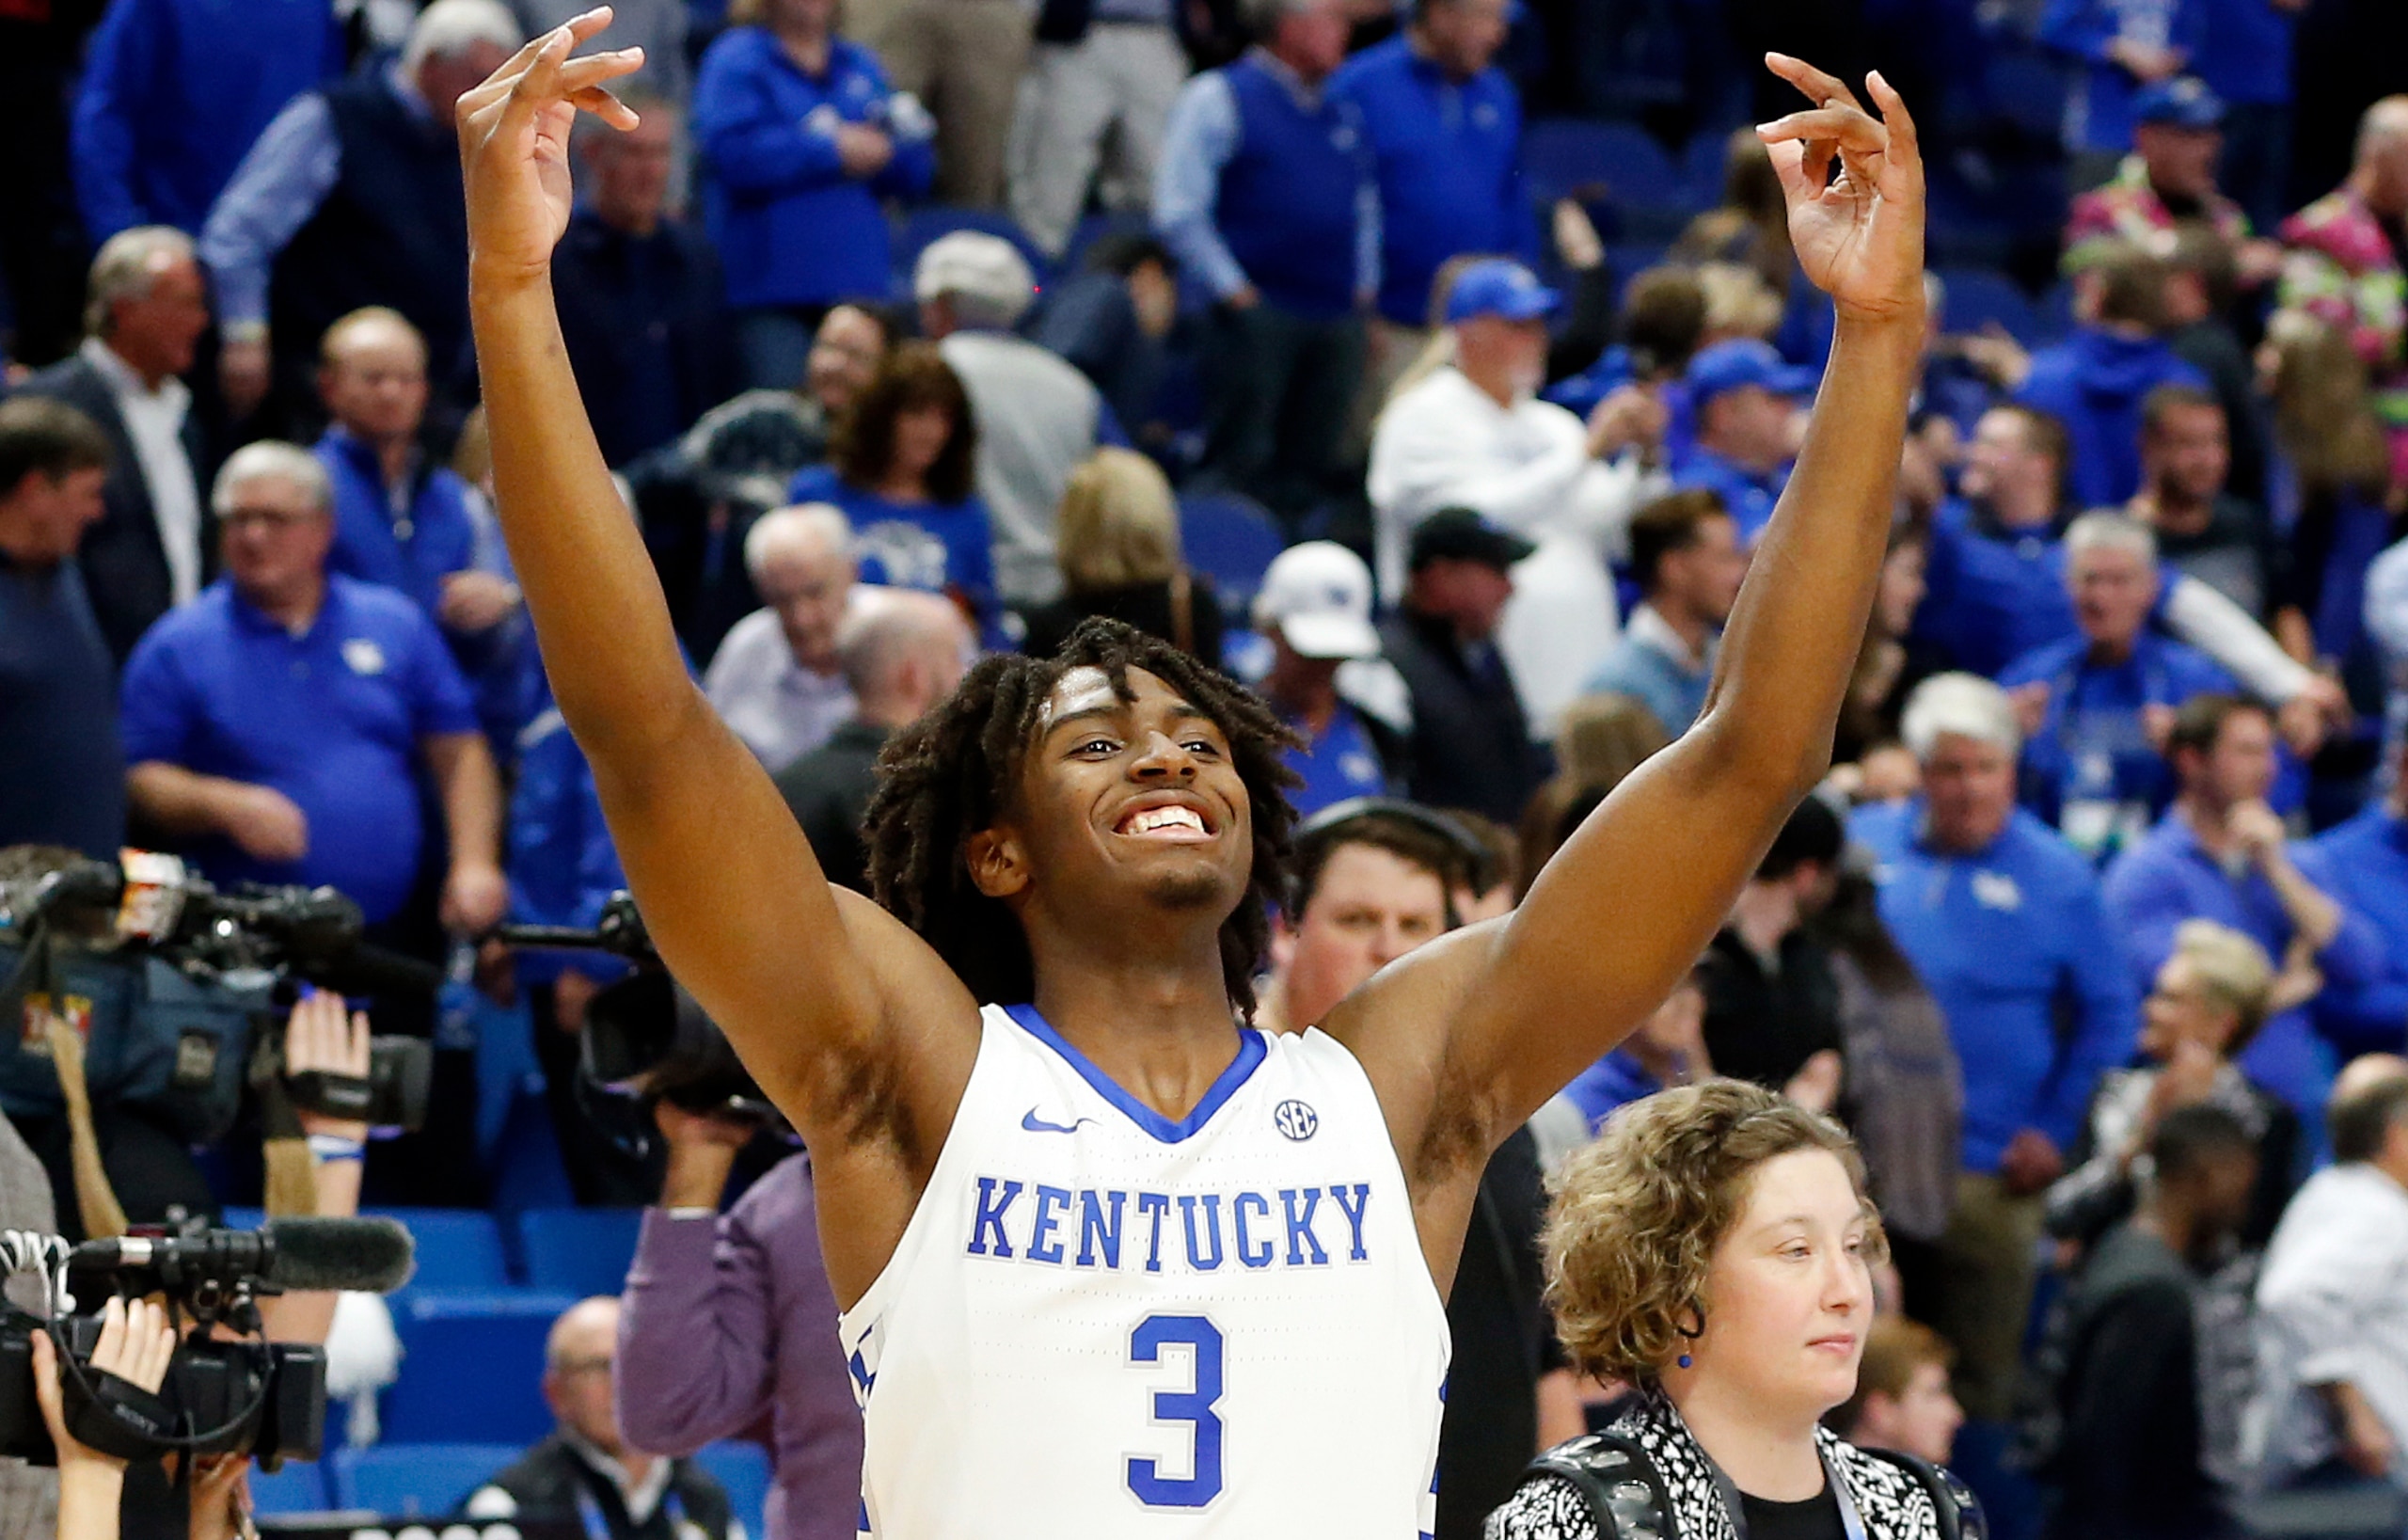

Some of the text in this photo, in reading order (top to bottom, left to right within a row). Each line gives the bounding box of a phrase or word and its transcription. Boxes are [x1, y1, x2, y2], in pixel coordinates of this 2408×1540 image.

[1275, 1101, 1316, 1139] SEC
[965, 1175, 1372, 1274] KENTUCKY
[1123, 1311, 1227, 1512] 3
